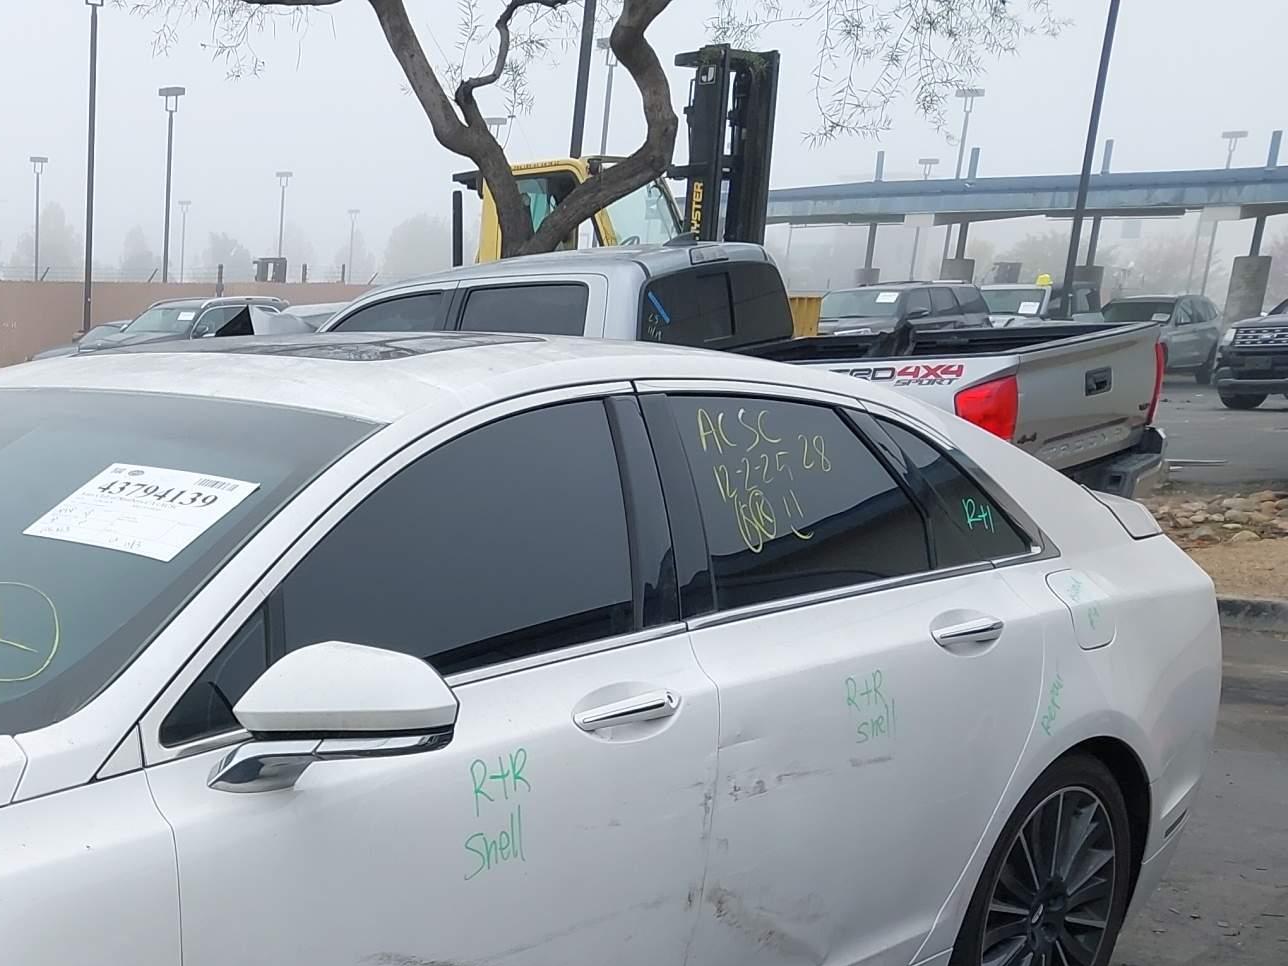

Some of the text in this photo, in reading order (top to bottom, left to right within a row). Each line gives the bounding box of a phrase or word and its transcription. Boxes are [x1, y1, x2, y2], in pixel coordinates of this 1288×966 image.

[691, 182, 704, 240] YSTER
[894, 377, 958, 388] SPORT
[98, 480, 220, 508] 43794139
[470, 747, 532, 818] R+R
